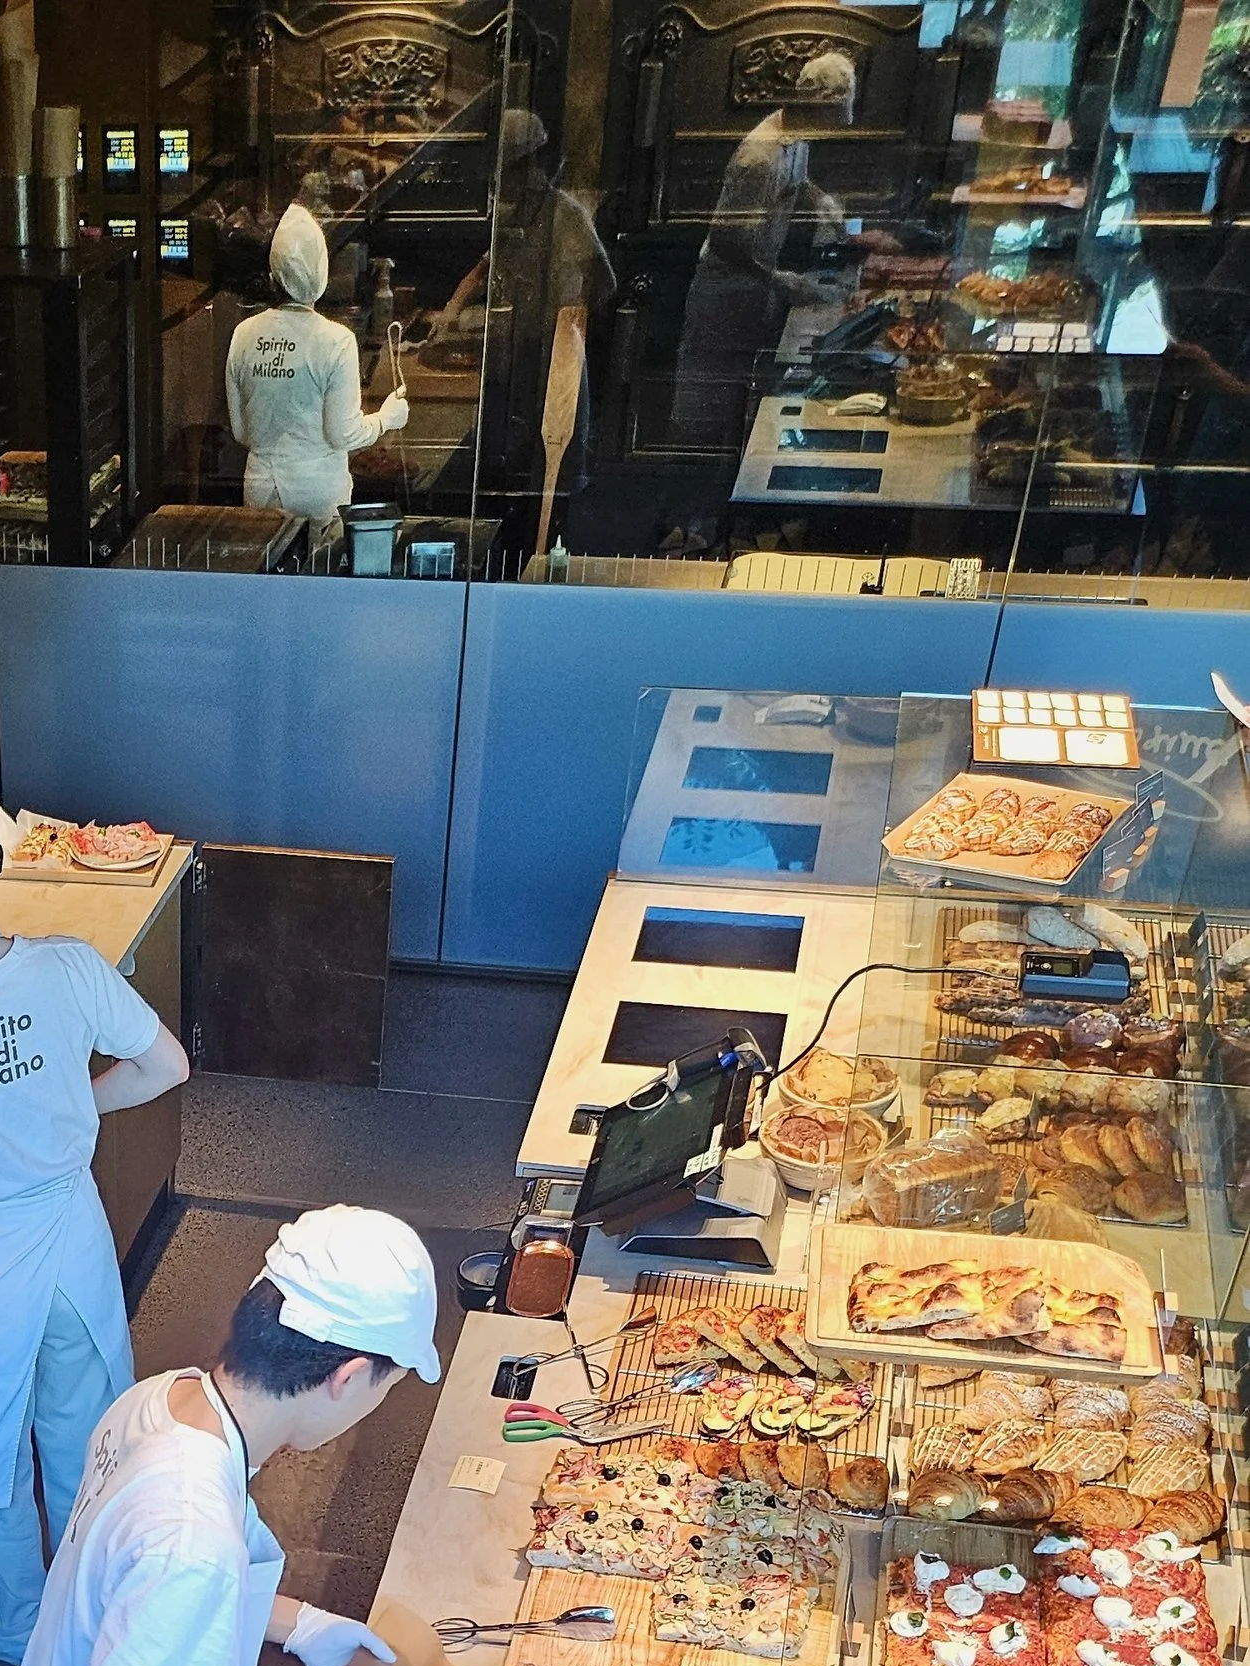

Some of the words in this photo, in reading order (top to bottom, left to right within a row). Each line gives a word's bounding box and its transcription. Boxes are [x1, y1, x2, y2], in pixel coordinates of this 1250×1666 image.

[255, 336, 296, 356] Spirito
[272, 353, 285, 367] di
[252, 362, 295, 378] Milano
